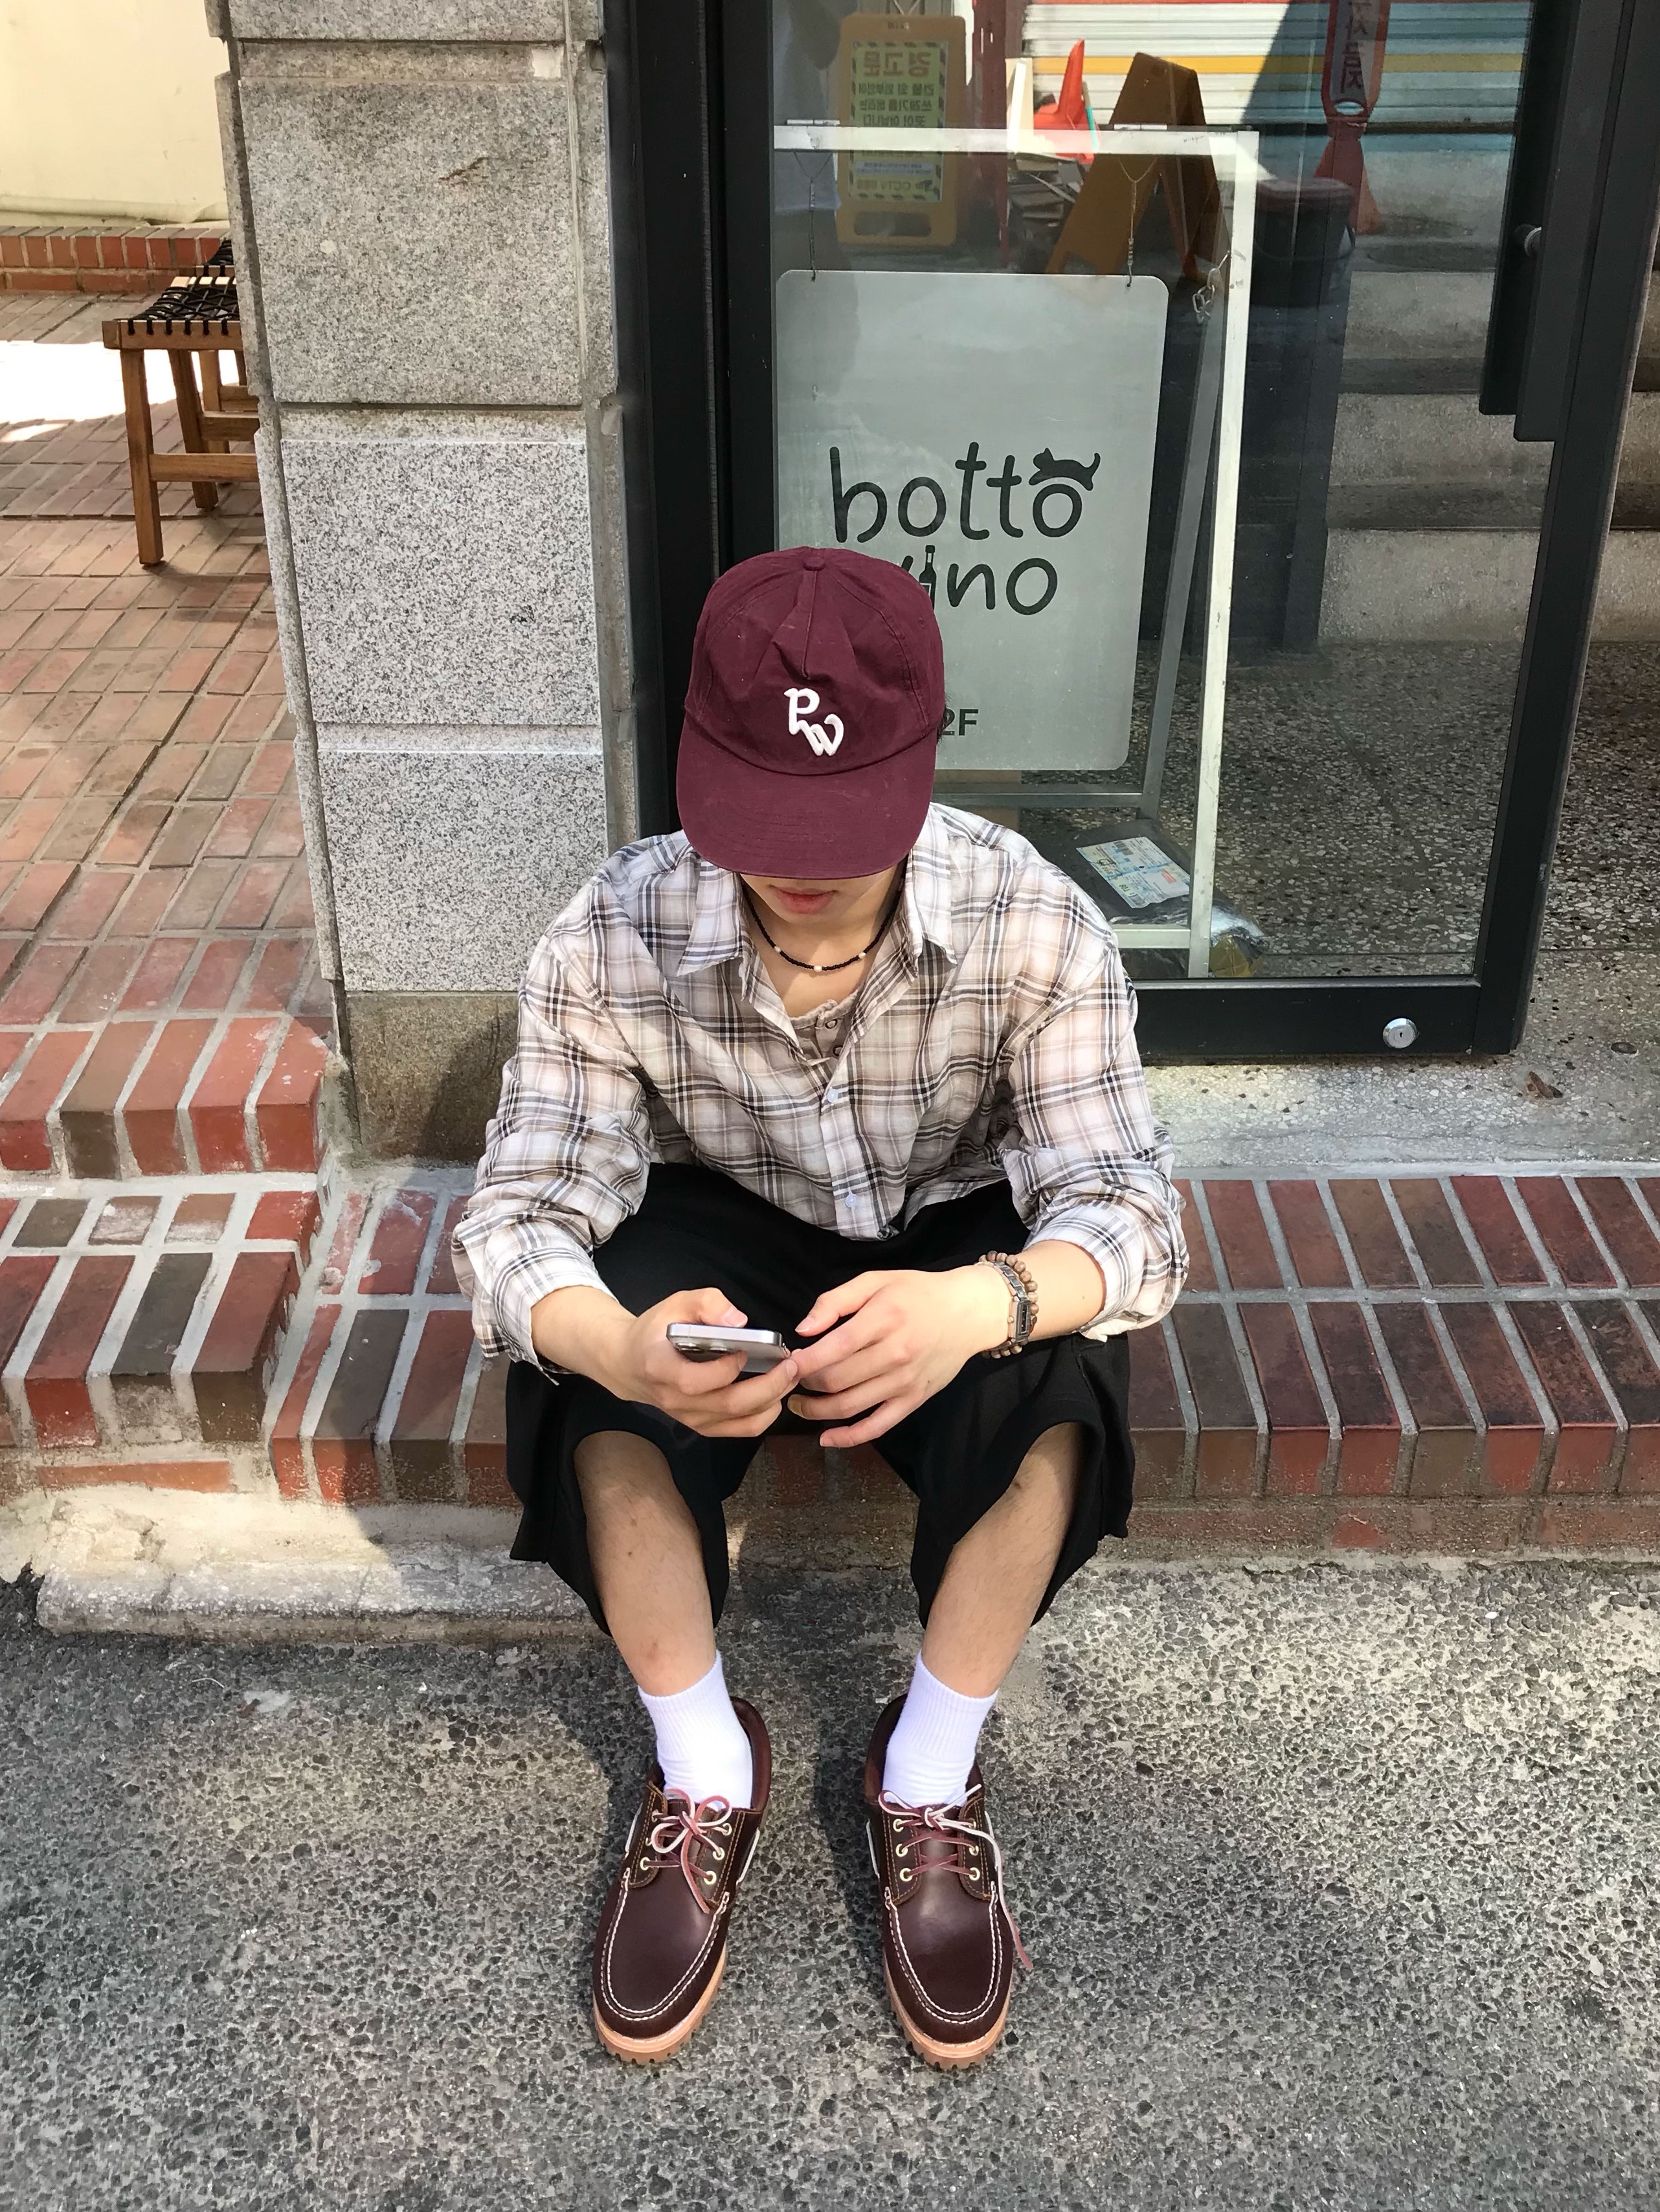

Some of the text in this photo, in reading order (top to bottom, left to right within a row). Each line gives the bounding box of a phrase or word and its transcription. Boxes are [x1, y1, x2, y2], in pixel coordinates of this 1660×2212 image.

[829, 442, 1082, 542] botto
[902, 540, 1058, 615] ino
[942, 709, 978, 735] 2F
